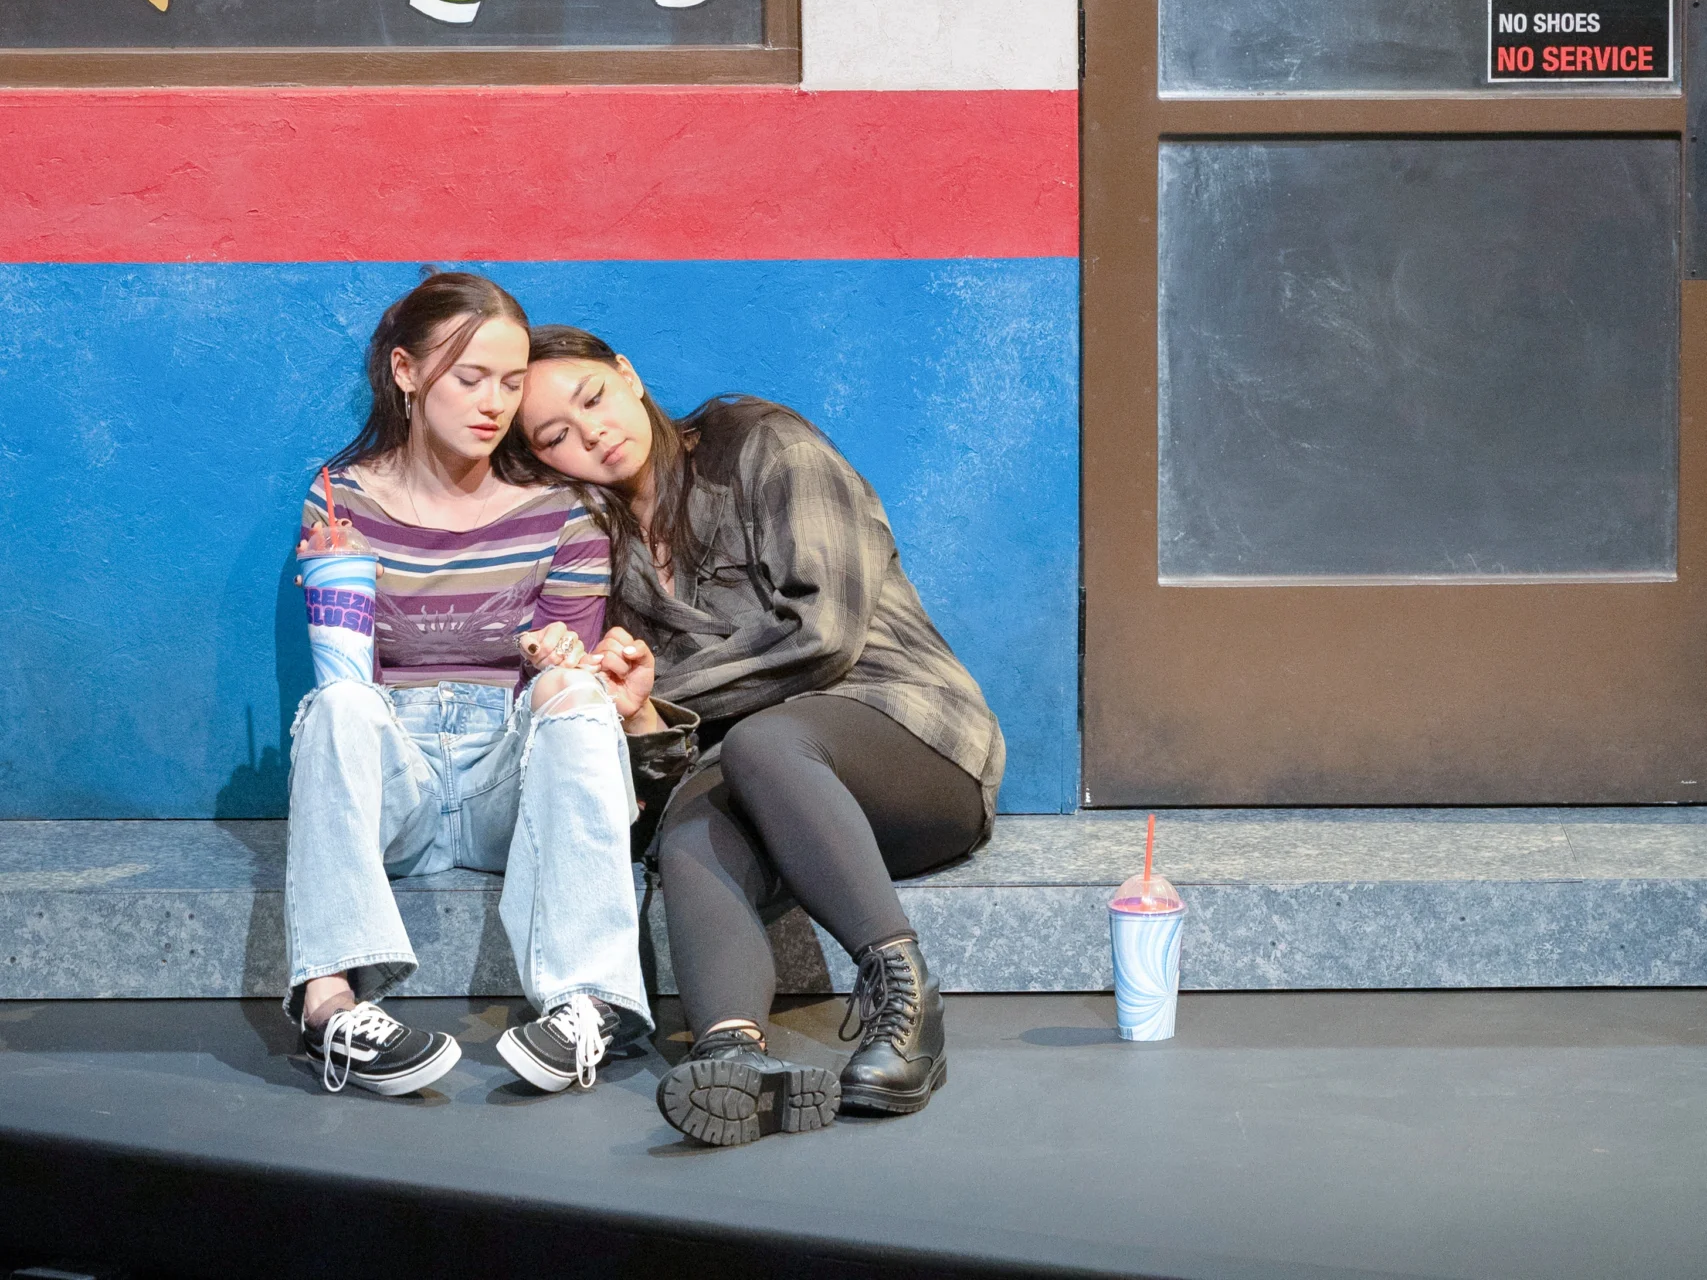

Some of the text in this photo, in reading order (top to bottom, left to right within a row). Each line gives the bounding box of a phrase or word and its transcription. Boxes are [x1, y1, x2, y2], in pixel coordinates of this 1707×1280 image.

[1498, 13, 1601, 34] NO SHOES
[1497, 46, 1654, 72] NO SERVICE
[304, 586, 376, 618] REEZI
